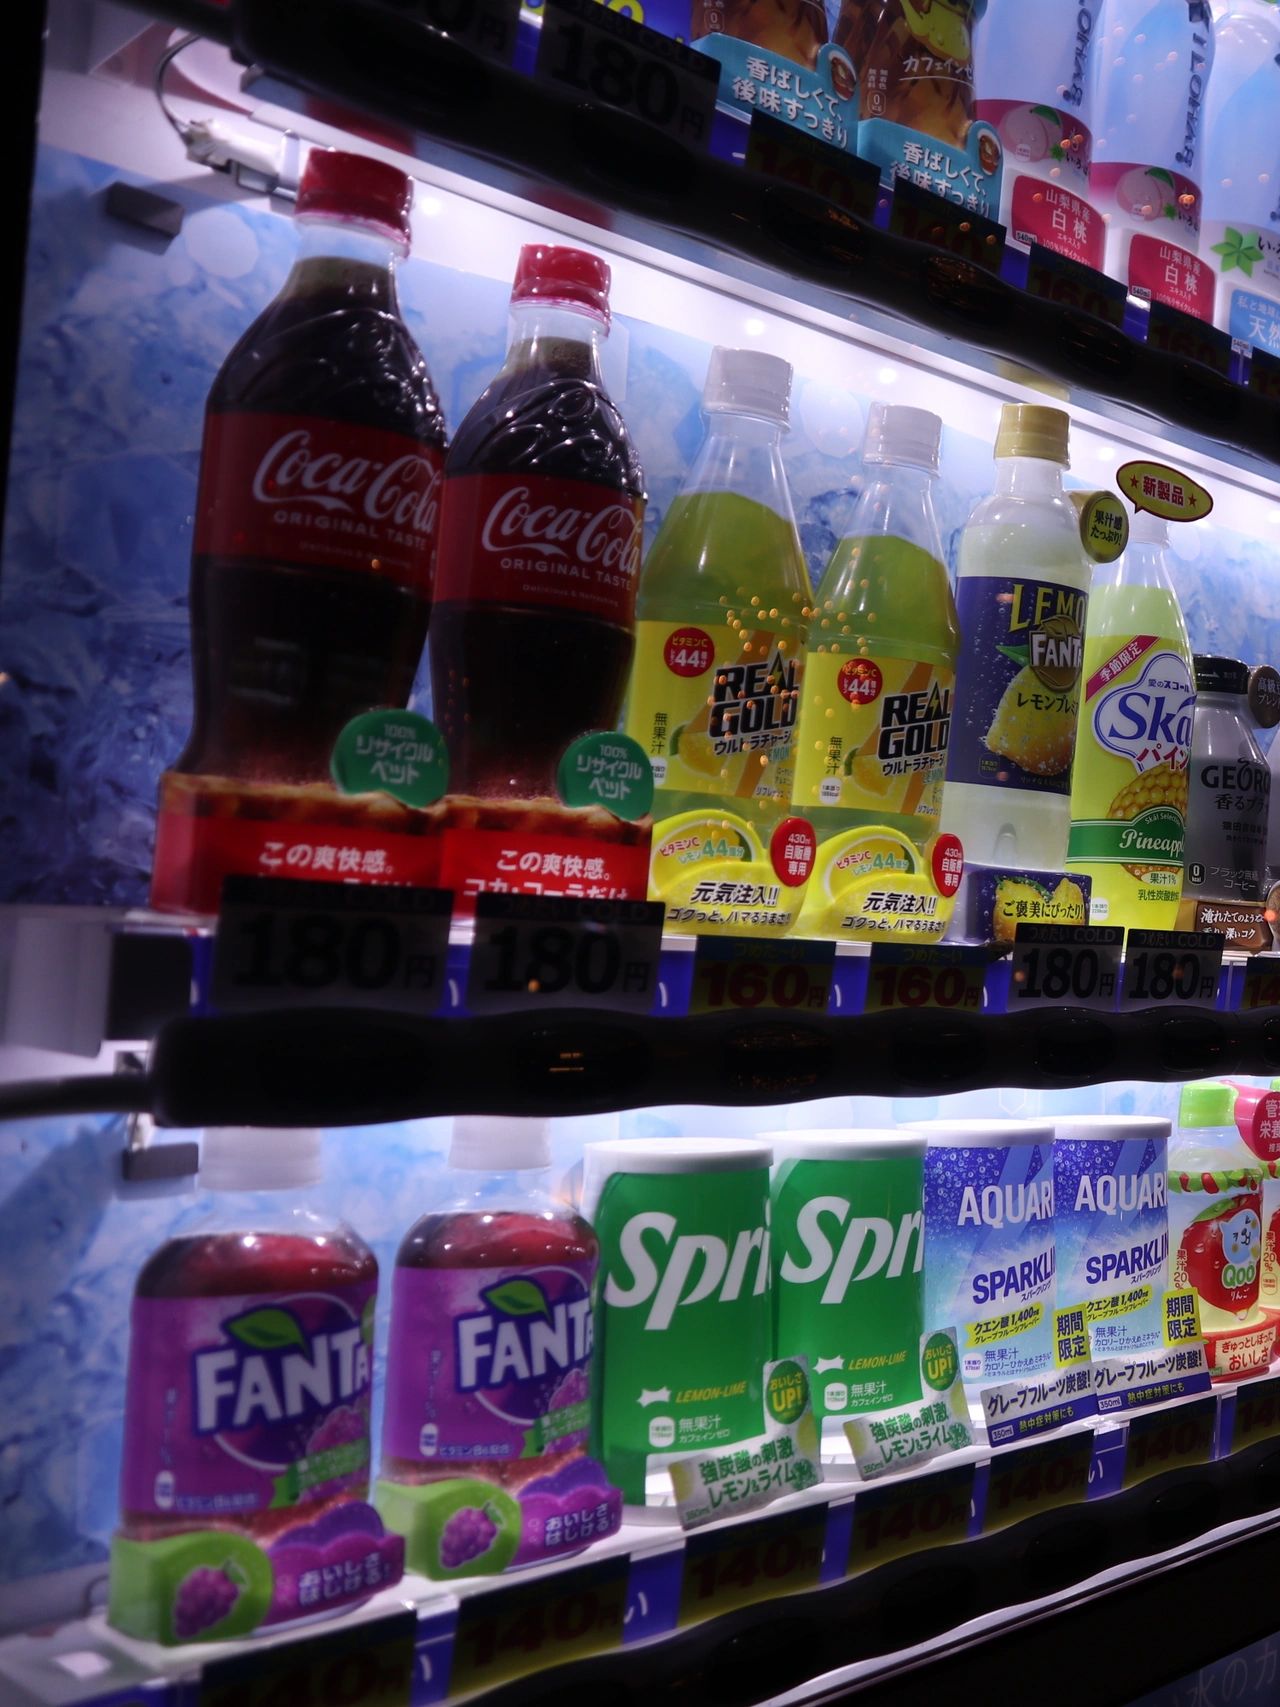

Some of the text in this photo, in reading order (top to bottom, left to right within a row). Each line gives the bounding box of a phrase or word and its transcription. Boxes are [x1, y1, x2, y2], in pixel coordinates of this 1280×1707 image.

[747, 57, 842, 121] 香ばしくて、
[732, 79, 848, 149] 後味すっきり
[904, 141, 989, 197] 香ばしくて、
[1142, 475, 1185, 507] 新製品
[273, 509, 430, 550] ORIGINAL TASTE
[481, 486, 643, 576] Coca-Cola
[1095, 510, 1123, 532] 果汁感
[500, 557, 633, 593] ORIGINAL TASTE
[671, 635, 709, 648] ビタミンC
[676, 650, 700, 669] 44
[842, 665, 878, 678] ビタミンC
[1099, 641, 1143, 684] 季節限定
[713, 651, 800, 702] REAL
[849, 679, 871, 695] 44
[880, 681, 951, 724] REAL
[709, 697, 798, 739] GOLD
[382, 722, 417, 742] 100%
[651, 711, 669, 755] 無果汁
[877, 718, 951, 761] GOLD
[356, 736, 434, 765] リサイクル
[598, 743, 630, 760] 100%
[825, 735, 843, 776] 無果汁
[370, 760, 420, 787] ペット
[576, 753, 644, 781] リサイクル
[588, 777, 632, 802] ペット
[258, 840, 394, 875] この爽快感。
[659, 836, 700, 859] ビタミンC
[783, 845, 812, 862] 自販機
[835, 850, 872, 871] ビタミンC
[496, 848, 612, 883] この爽快感。
[787, 860, 807, 877] 専用
[943, 872, 960, 889] 専用
[1149, 872, 1177, 886] 果汁1%
[1224, 878, 1258, 891] コーヒー
[689, 880, 781, 907] 元気注入!!
[861, 889, 939, 916] 元気注入!!
[1002, 898, 1085, 920] ご褒美にぴったり!
[1200, 908, 1265, 924] 淹れたてのような
[1262, 1231, 1276, 1272] 果汁20%
[1222, 1260, 1256, 1289] Qoo
[1086, 1293, 1119, 1312] クエン酸
[1165, 1294, 1195, 1319] 期間
[1230, 1287, 1251, 1301] りんご
[972, 1316, 1010, 1335] クエン酸
[1055, 1309, 1084, 1337] 期間
[1094, 1325, 1128, 1339] 無果汁
[1166, 1316, 1198, 1341] 限定
[924, 1344, 954, 1362] おいしさ
[1057, 1336, 1088, 1363] 限定
[1093, 1335, 1142, 1348] カロリーひかえめ
[1221, 1329, 1275, 1355] ぎゅっとしぼった
[847, 1350, 908, 1371] LEMON-LIME
[983, 1357, 1033, 1371] カロリーひかえめ
[984, 1347, 1019, 1363] 無果汁
[1228, 1346, 1270, 1372] おいしさ
[768, 1372, 804, 1390] おいしさ
[926, 1356, 954, 1381] UP!
[1093, 1348, 1203, 1389] グレープフルーツ炭酸!
[674, 1380, 748, 1404] LEMON-LIME
[771, 1386, 804, 1414] UP!
[850, 1380, 889, 1396] 無果汁
[850, 1392, 895, 1408] カフェインゼロ
[987, 1369, 1092, 1420] グレープフルーツ炭酸!
[1126, 1382, 1185, 1404] 熱中症対策にも
[1099, 1397, 1122, 1409] 350ml
[677, 1413, 723, 1431] 無果汁
[868, 1401, 950, 1444] 強炭酸の刺激
[1018, 1404, 1075, 1434] 熱中症対策にも
[677, 1429, 732, 1444] カフェインゼロ
[879, 1427, 953, 1465] レモン&ライム
[991, 1426, 1014, 1442] 350ml
[698, 1436, 796, 1487] 強炭酸の刺激
[707, 1459, 798, 1508] レモン&ライム
[545, 1503, 609, 1532] おいしさ
[545, 1514, 617, 1547] はじける!
[299, 1552, 383, 1589] おいしさ
[299, 1563, 394, 1607] はじける!
